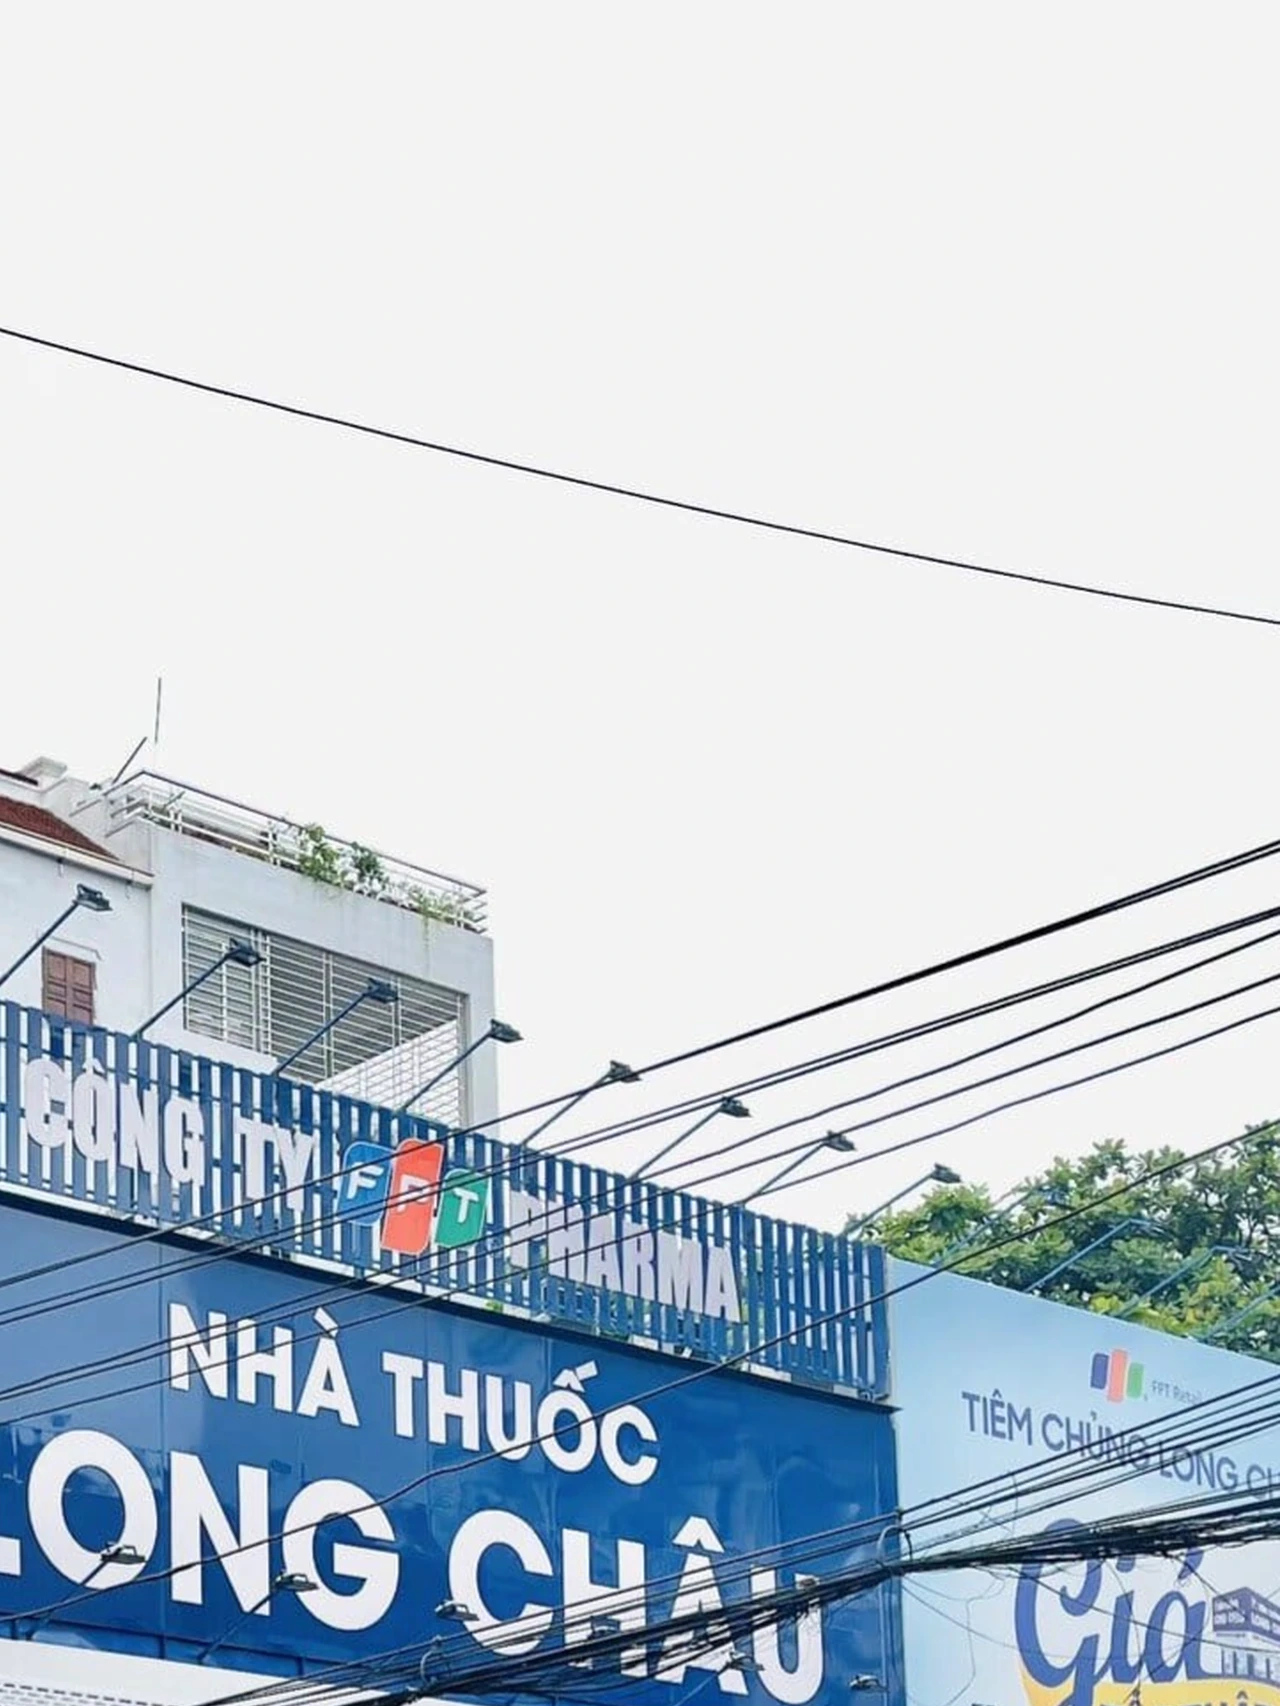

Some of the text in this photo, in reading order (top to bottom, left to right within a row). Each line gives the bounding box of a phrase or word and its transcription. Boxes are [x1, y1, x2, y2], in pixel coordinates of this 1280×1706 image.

[25, 1056, 742, 1323] CÔNG TY FPT PHARMA
[168, 1303, 659, 1486] NHÀ THUỐC
[961, 1388, 1033, 1447] TIÊM
[1041, 1410, 1151, 1471] CHỦNG
[1159, 1440, 1238, 1492] LONG
[447, 1508, 823, 1705] CHÂU
